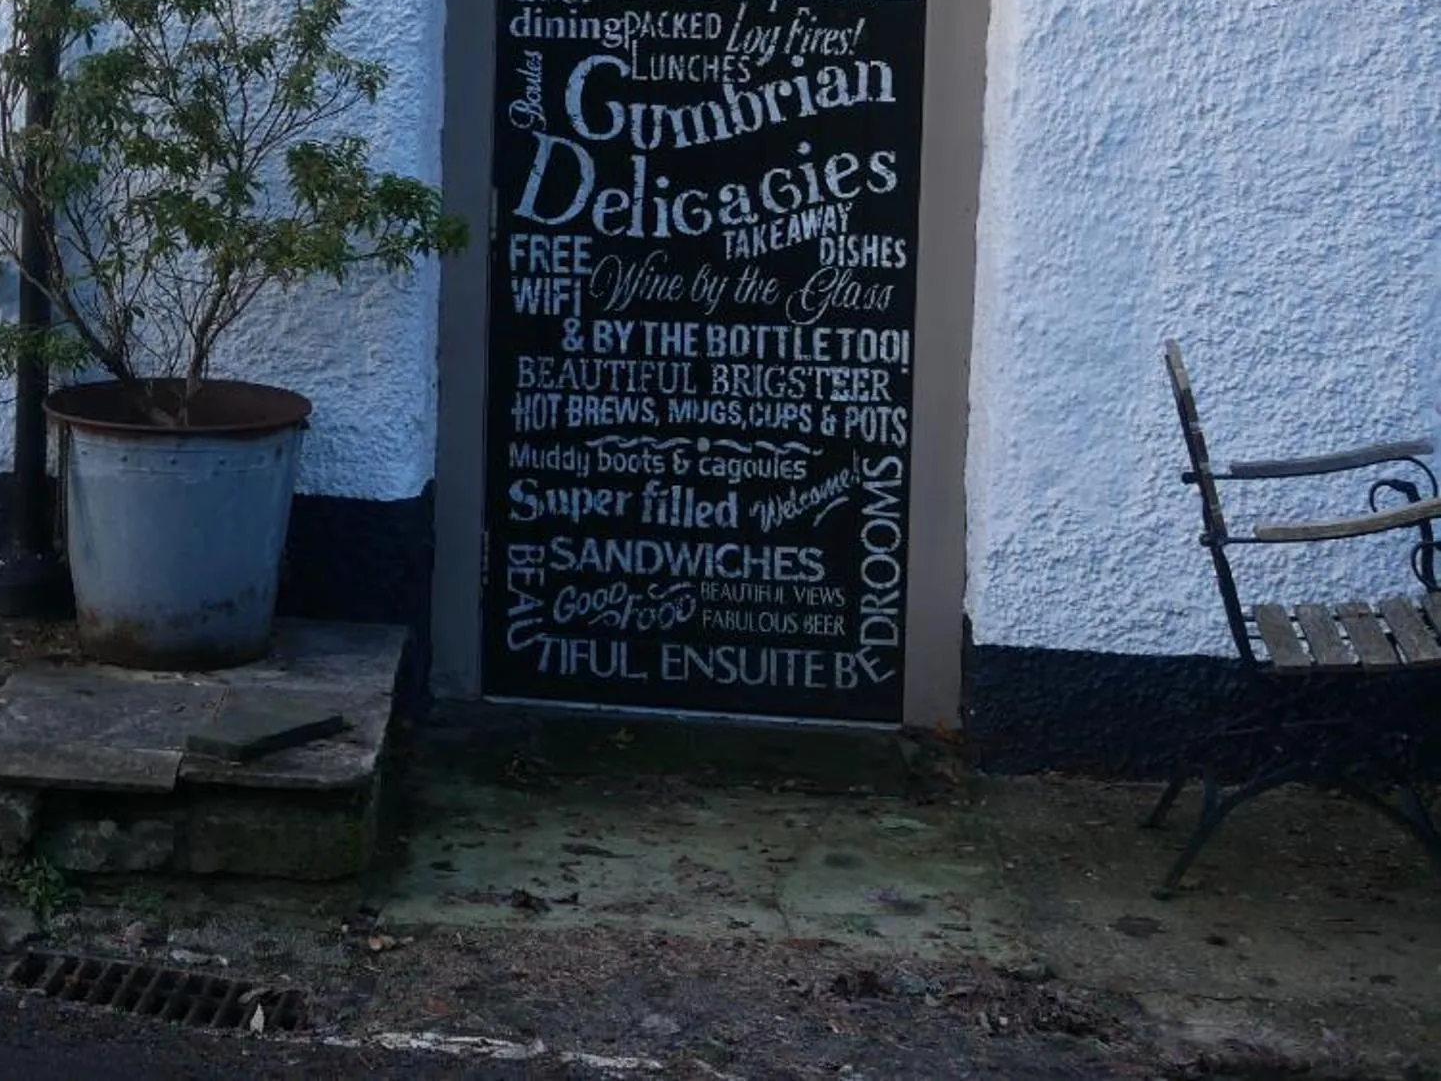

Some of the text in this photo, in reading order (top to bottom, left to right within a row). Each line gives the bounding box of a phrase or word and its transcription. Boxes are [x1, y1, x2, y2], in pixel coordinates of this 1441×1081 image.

[509, 7, 627, 48] dining
[624, 11, 722, 51] PACKED
[725, 1, 866, 65] Log Fires!
[631, 39, 752, 84] LUNCHES
[564, 54, 897, 151] Cumbrian
[512, 130, 899, 239] Delicacies
[509, 233, 593, 275] FREE
[722, 202, 853, 261] TAKEAWAY
[819, 234, 907, 270] DISHES
[511, 277, 581, 318] WIFI
[589, 250, 896, 327] Wine by the Glass
[562, 317, 911, 374] & BY THE BOTTLE TOO!
[516, 355, 891, 403] BEAUTIFUL BRIGSTEER
[511, 392, 908, 449] HOT BREWS, MUGS, CUPS & POTS
[508, 441, 808, 484] Muddy boots & cagoules
[507, 477, 740, 530] Super filled
[549, 535, 825, 582] SANDWICHES
[700, 581, 845, 608] BEAUTIFUL VIEWS
[702, 612, 846, 638] FABULOUS BEER
[662, 643, 825, 689] ENSUITE
